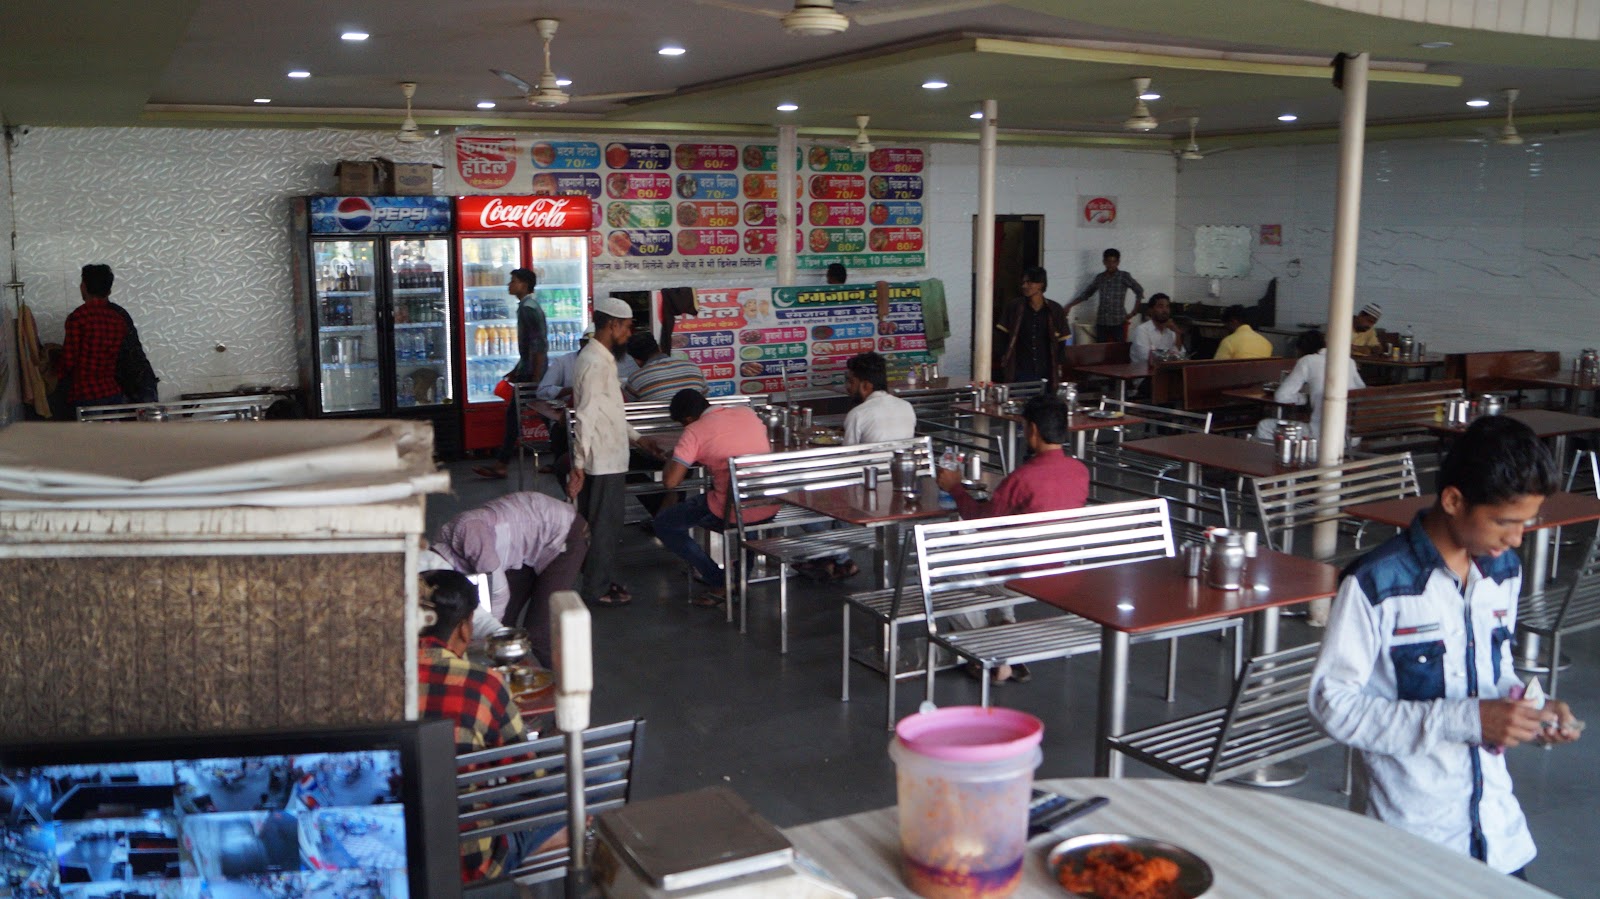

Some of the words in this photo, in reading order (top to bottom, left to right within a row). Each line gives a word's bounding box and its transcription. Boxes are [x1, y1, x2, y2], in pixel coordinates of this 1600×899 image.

[461, 156, 508, 177] हॉटेल
[565, 158, 591, 168] 70/-
[637, 160, 663, 169] 70/-
[704, 160, 729, 169] 60/-
[706, 190, 730, 199] 70/-
[835, 190, 858, 199] 70/-
[894, 191, 916, 199] 70/-
[374, 207, 428, 220] PEPSI
[480, 198, 570, 228] Coca-Cola
[709, 218, 733, 227] 50/-
[639, 244, 664, 254] 60/-
[869, 255, 880, 265] 10
[798, 290, 865, 303] रमजान
